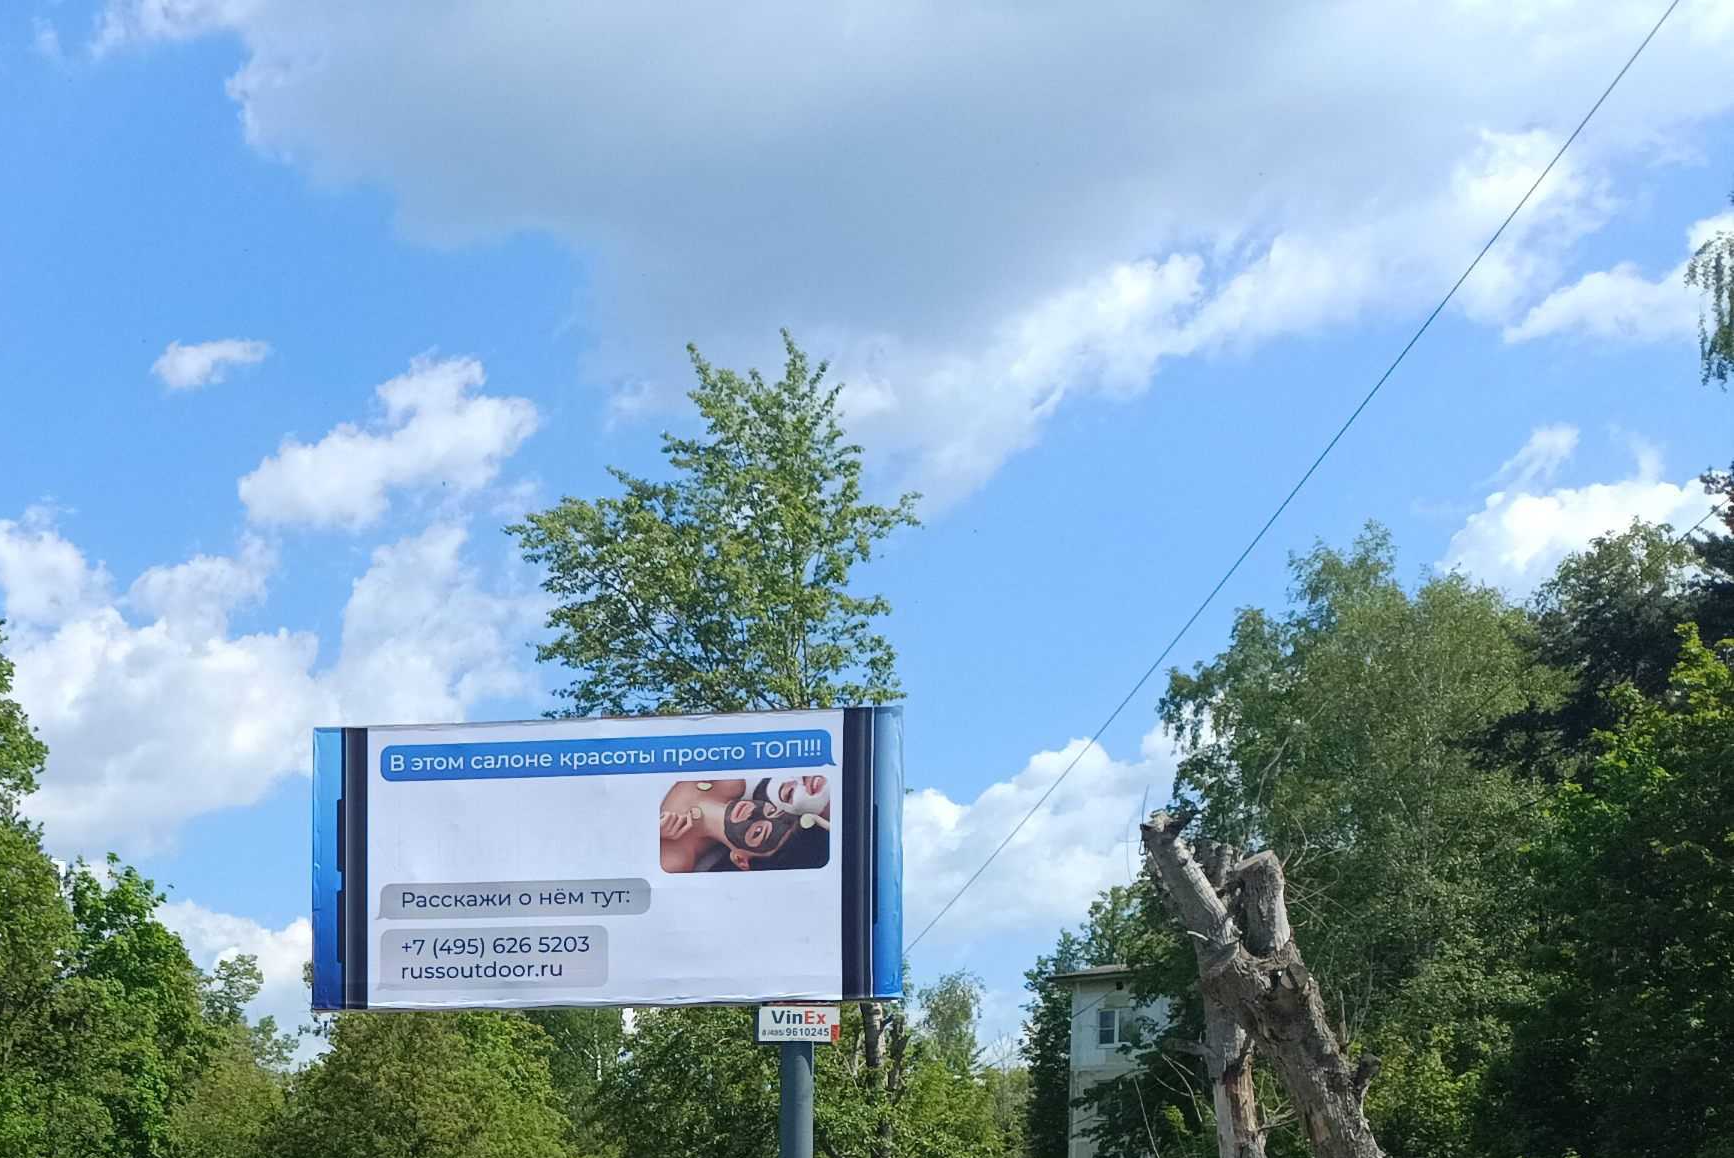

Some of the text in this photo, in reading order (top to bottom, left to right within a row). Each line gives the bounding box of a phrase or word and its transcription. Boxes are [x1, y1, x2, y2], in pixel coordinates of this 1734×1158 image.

[389, 738, 822, 772] В этом салоне красоты просто ТОП!!!
[401, 887, 631, 909] Расскажи о нём тут:
[401, 935, 590, 960] +7 (495) 626 5203
[401, 960, 564, 980] russoutdoor.ru
[771, 1009, 827, 1025] VinEx
[785, 1027, 830, 1037] 9610245
